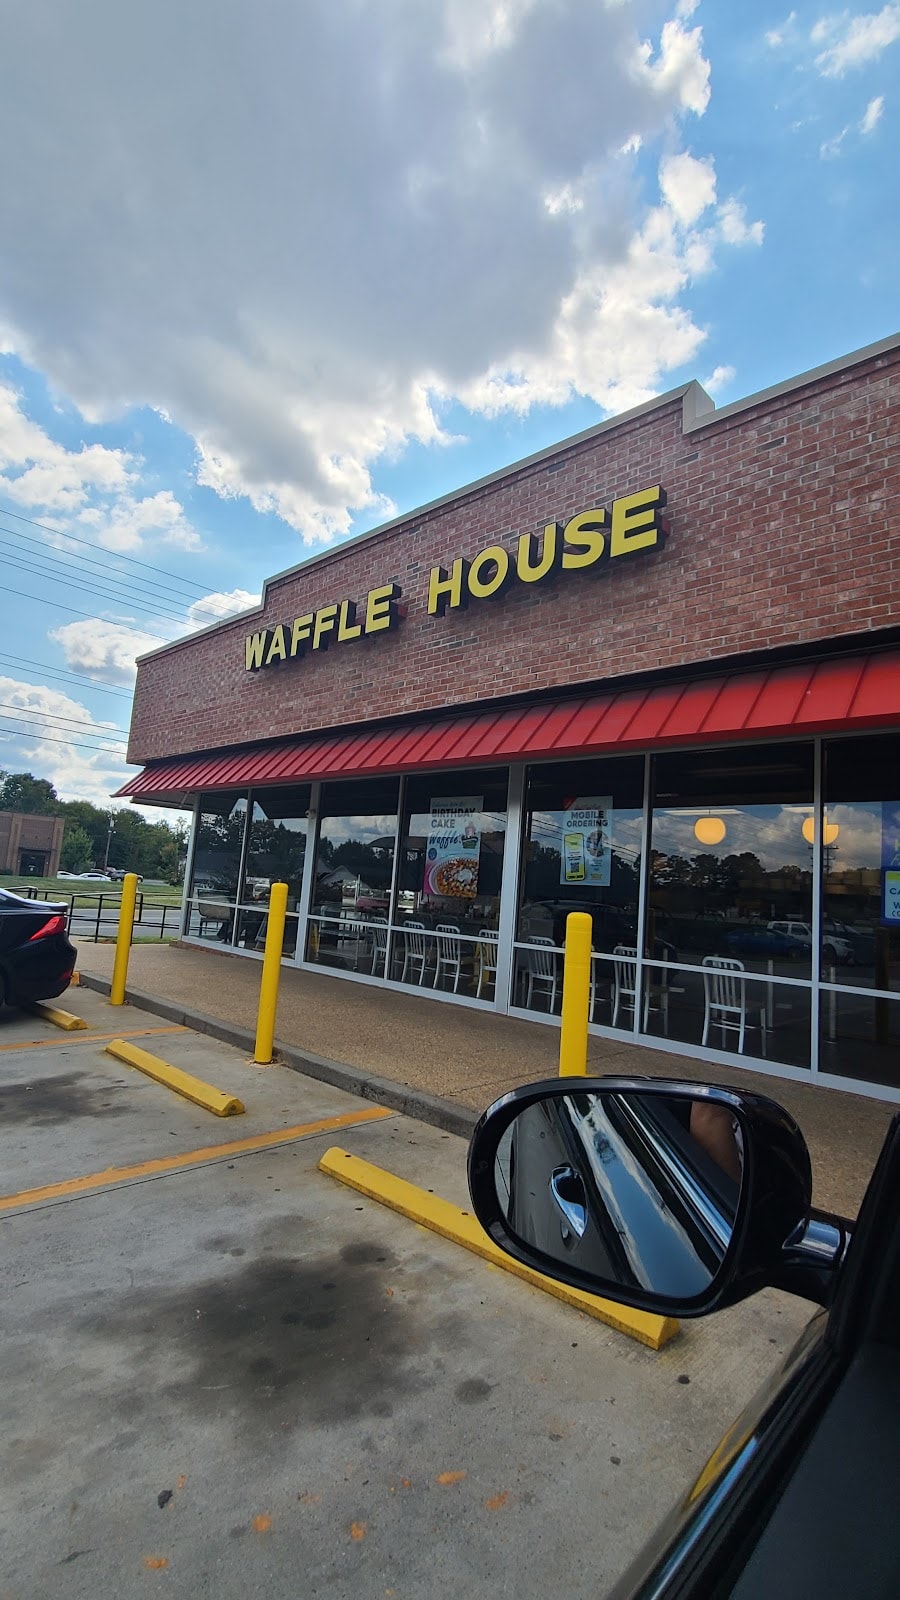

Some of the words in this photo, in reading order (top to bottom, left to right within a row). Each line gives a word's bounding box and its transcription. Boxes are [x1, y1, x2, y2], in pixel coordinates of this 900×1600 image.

[245, 583, 398, 671] WAFFLE
[427, 485, 664, 615] HOUSE
[431, 807, 476, 818] BIRTHDAY
[571, 811, 605, 819] MOBILE
[431, 819, 456, 829] CAKE
[566, 820, 608, 828] ORDERING
